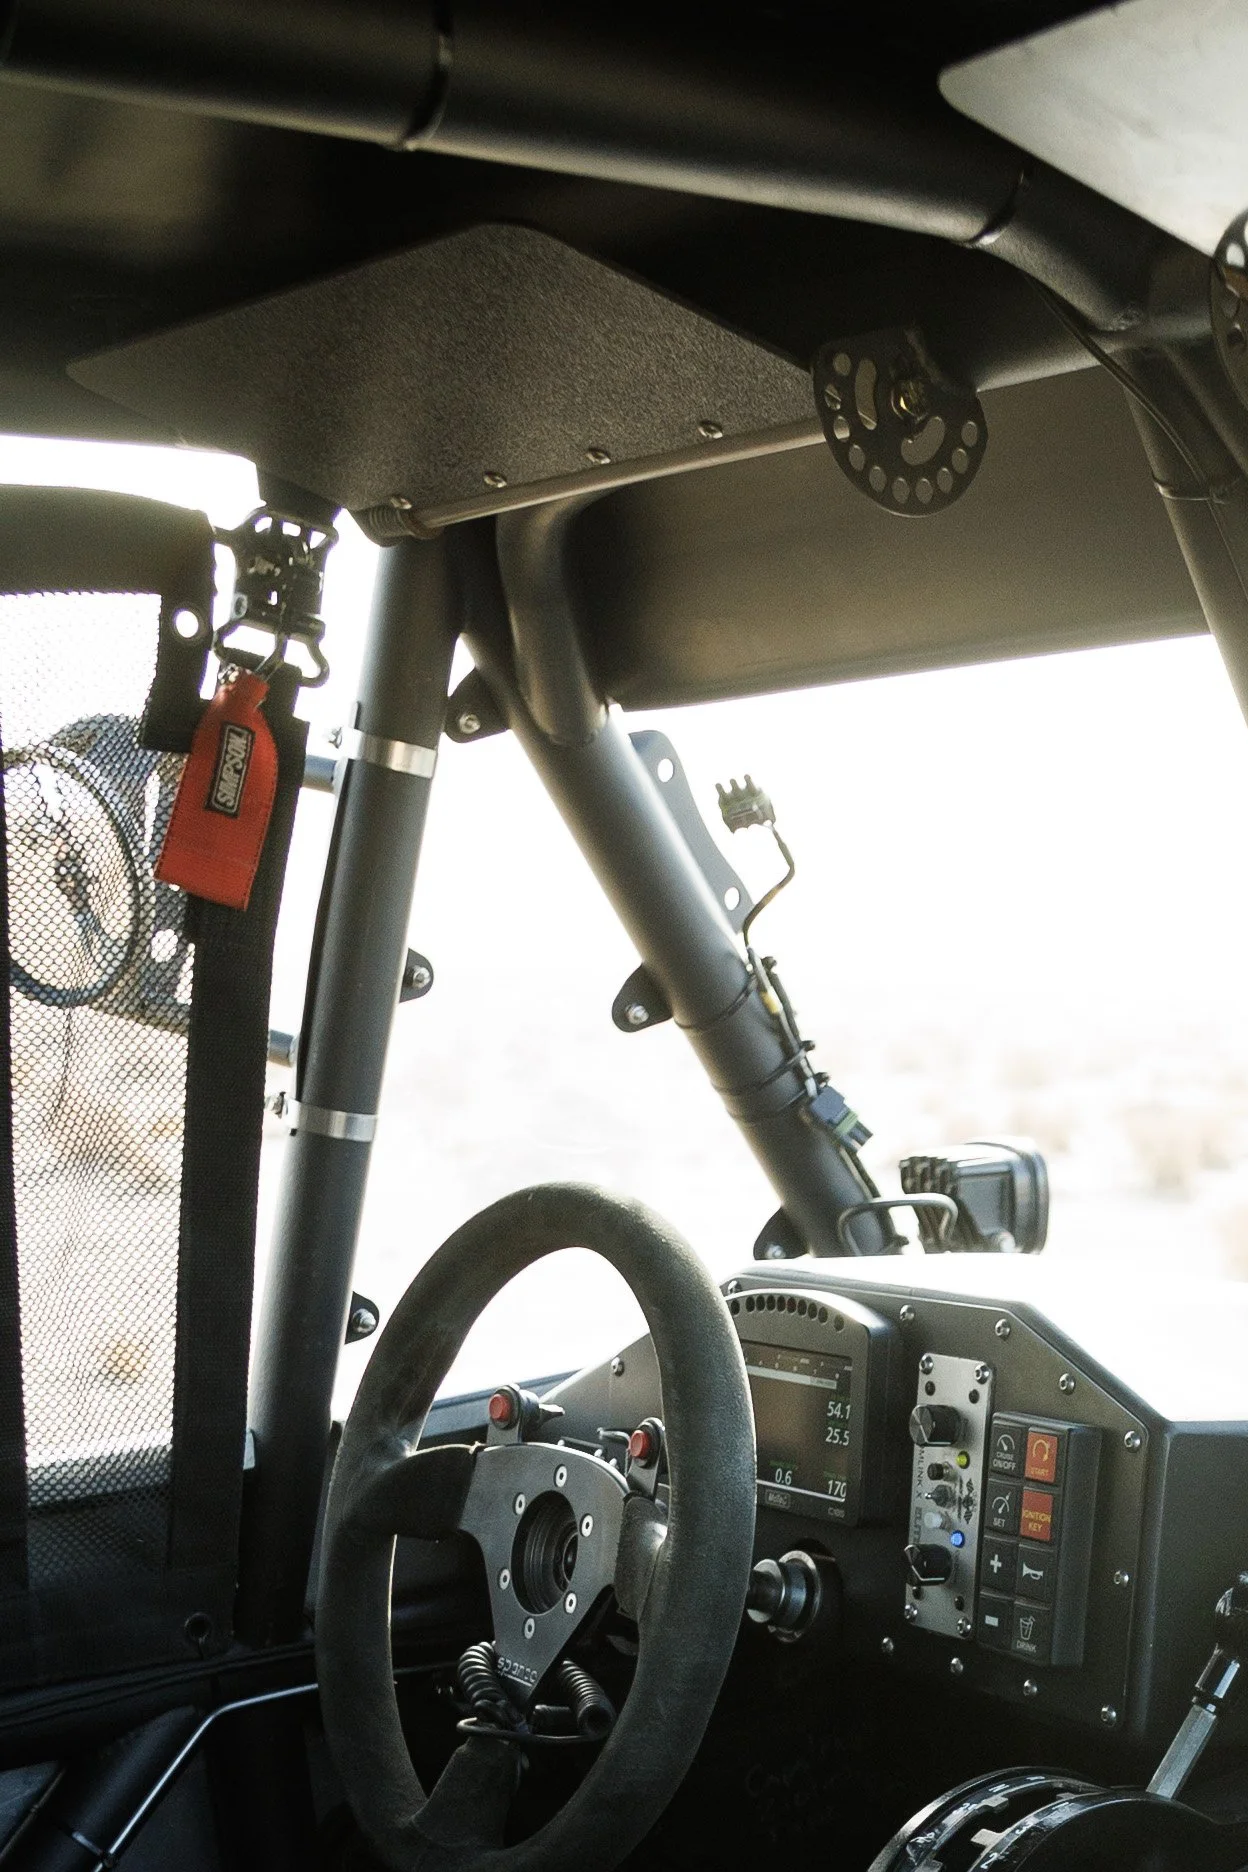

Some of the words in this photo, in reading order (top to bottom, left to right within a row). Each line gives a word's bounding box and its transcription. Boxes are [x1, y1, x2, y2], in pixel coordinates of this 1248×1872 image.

[216, 731, 247, 807] SIMPSON
[827, 1400, 851, 1420] 54.1
[825, 1426, 850, 1447] 25.5
[775, 1467, 793, 1486] 0.6
[827, 1479, 848, 1498] 170
[992, 1517, 1005, 1528] SET
[1028, 1522, 1043, 1532] KEY
[1016, 1639, 1037, 1653] DRINK
